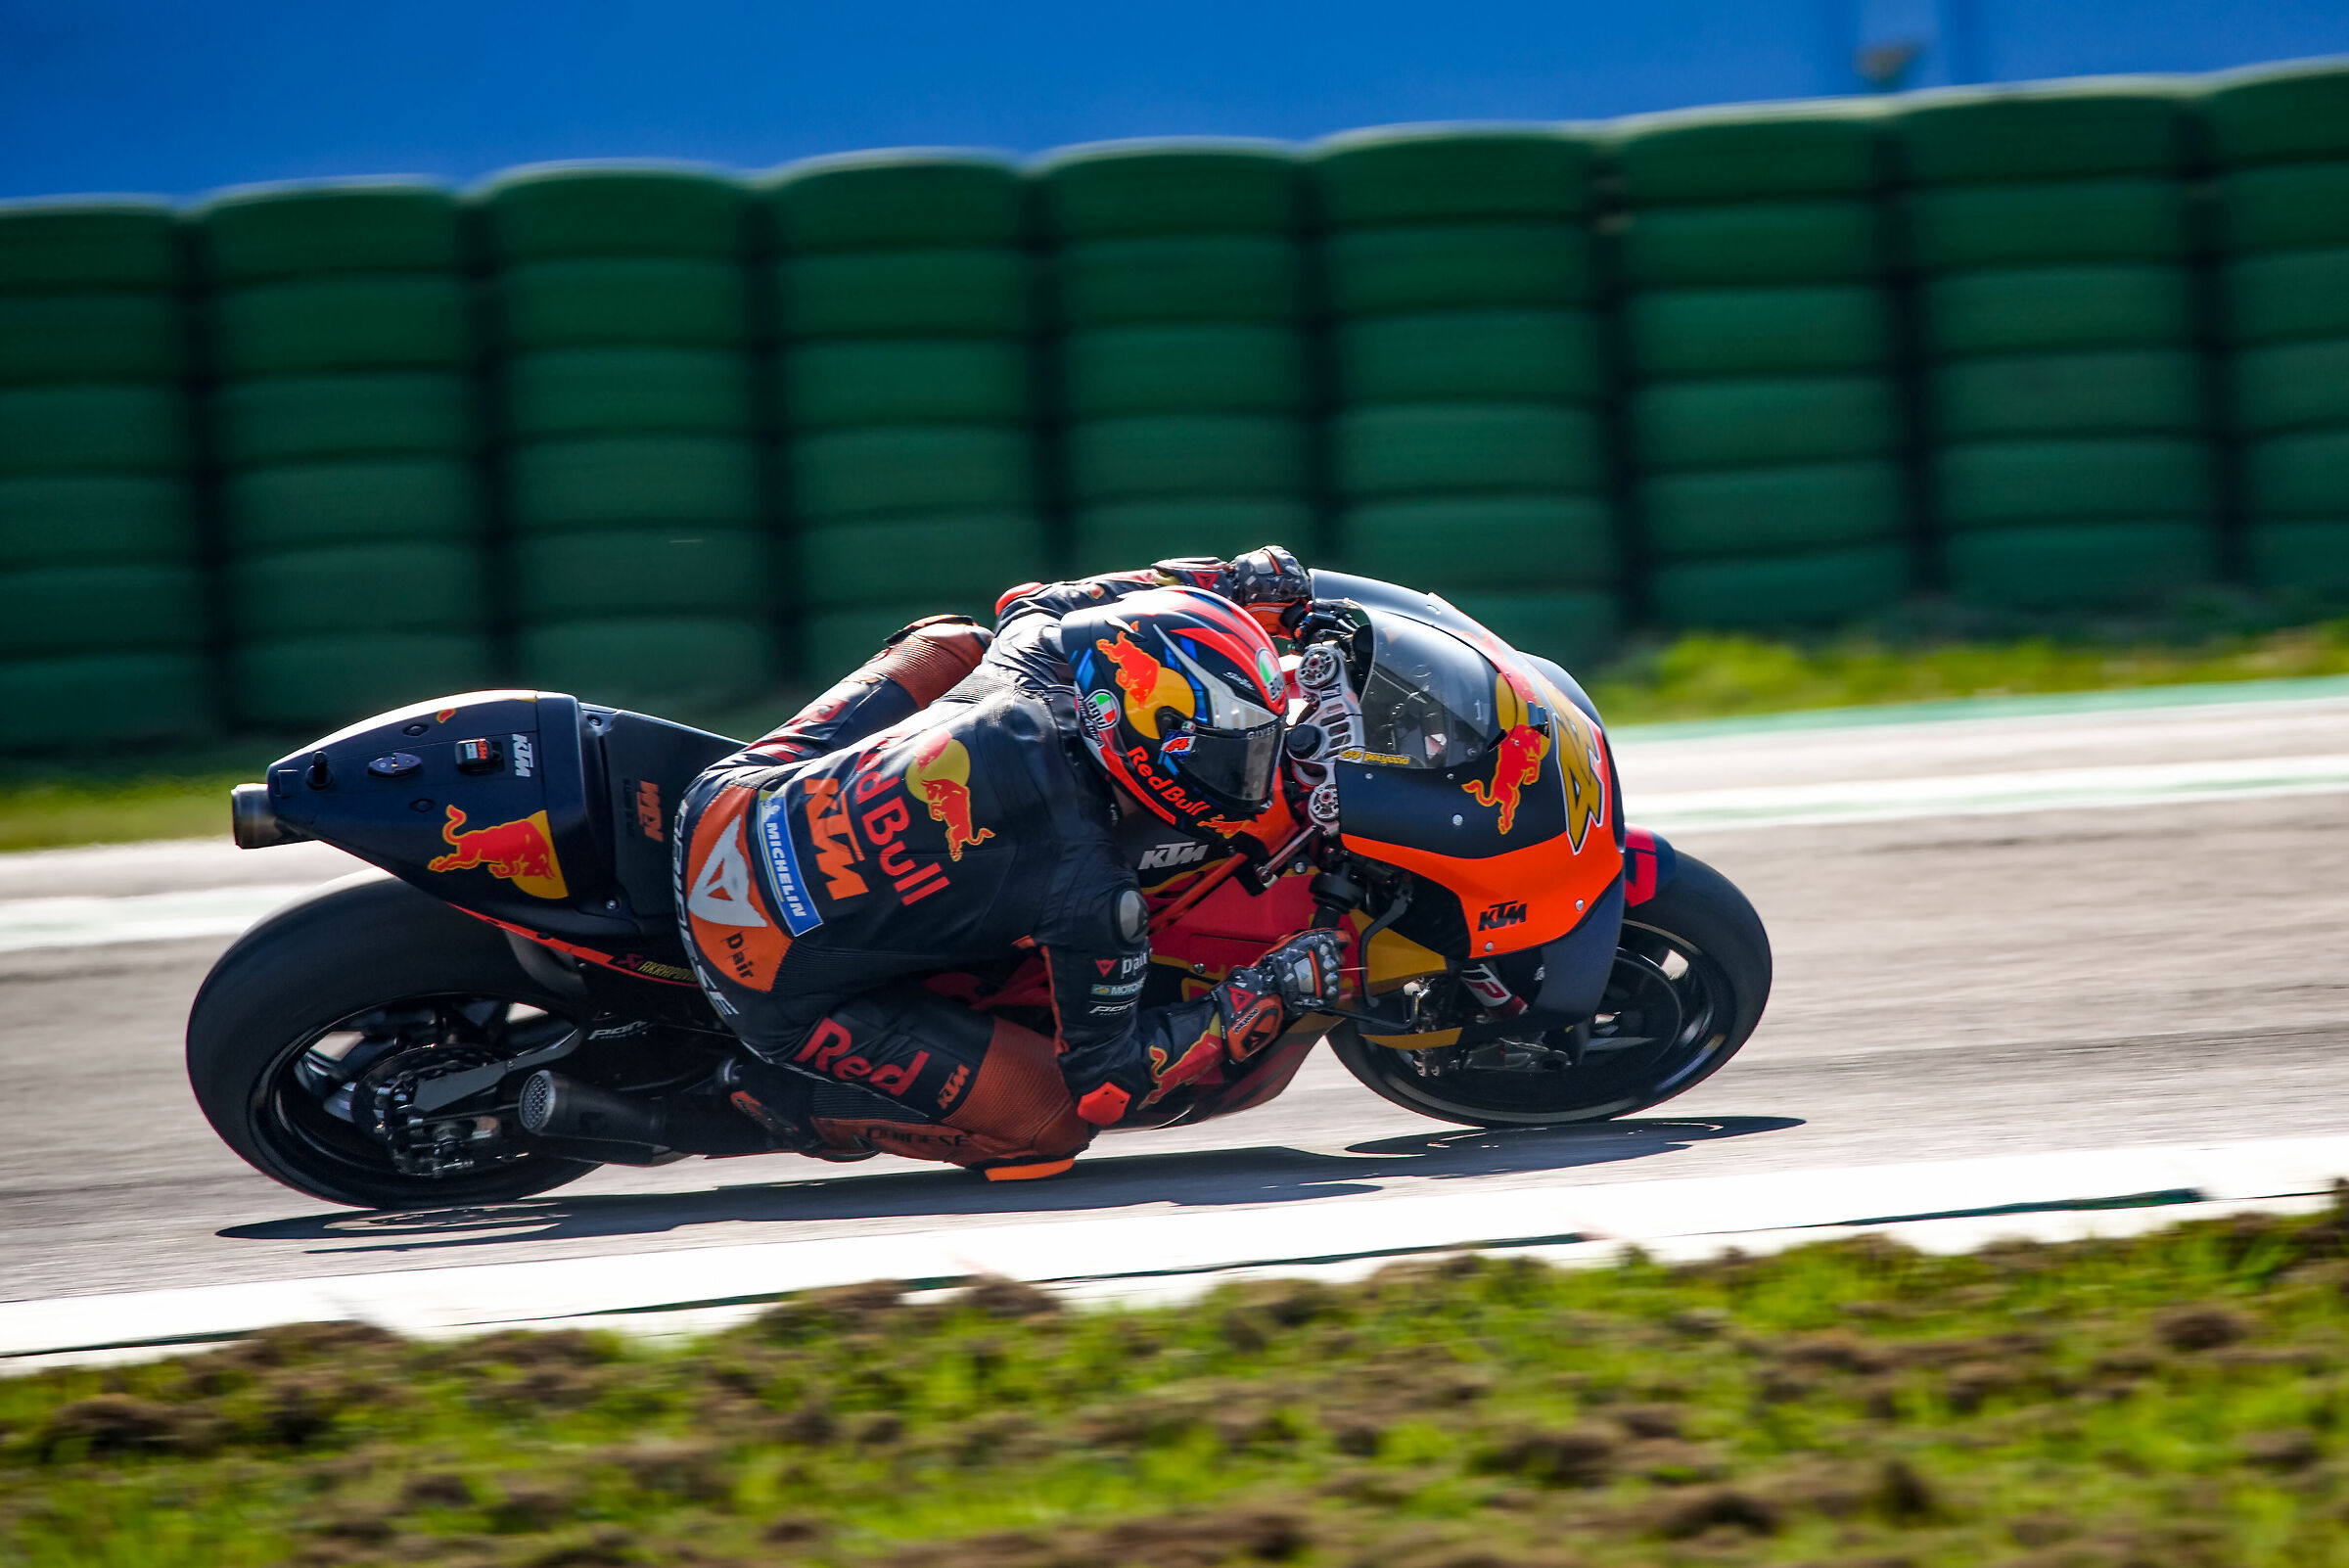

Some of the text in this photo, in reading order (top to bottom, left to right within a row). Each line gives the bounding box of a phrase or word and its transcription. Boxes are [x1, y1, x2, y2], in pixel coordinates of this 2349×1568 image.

[512, 734, 534, 777] KTM
[1127, 745, 1211, 816] Red Bull
[636, 780, 664, 843] KTM
[804, 777, 870, 901] KTM
[766, 821, 807, 918] MICHELIN
[861, 795, 950, 906] Bull
[1137, 841, 1210, 870] KTM
[1478, 899, 1528, 932] KTM
[794, 1017, 931, 1096] Red
[937, 1064, 971, 1110] KTM
